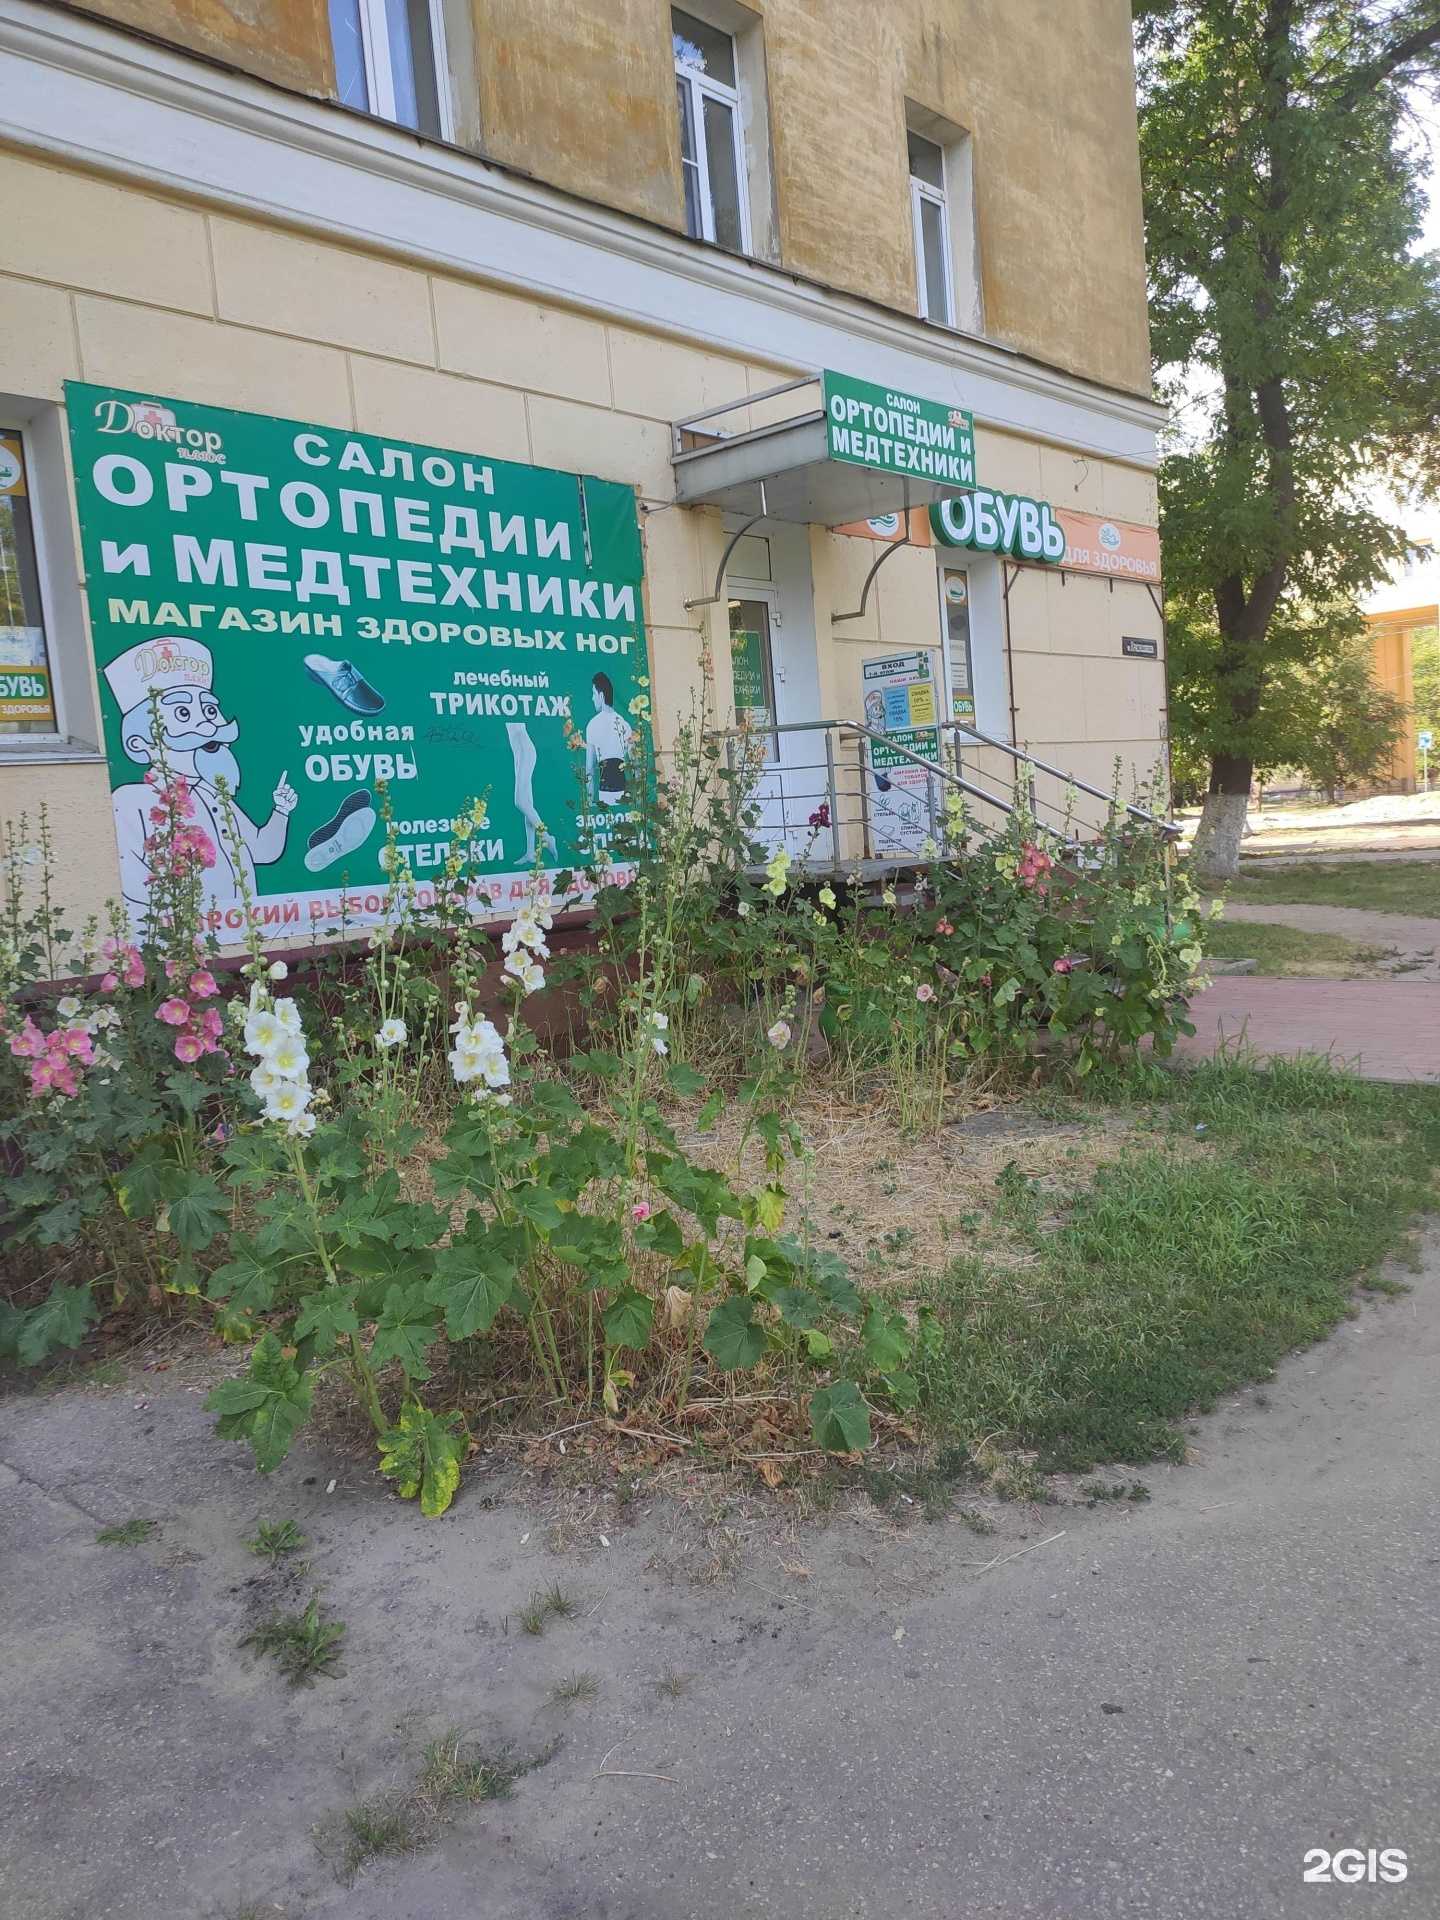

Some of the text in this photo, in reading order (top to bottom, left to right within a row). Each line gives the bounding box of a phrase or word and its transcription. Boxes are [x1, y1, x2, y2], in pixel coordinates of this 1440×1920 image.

[830, 394, 955, 451] ОРТОПЕДИИ
[886, 393, 921, 415] САЛОН
[293, 433, 495, 495] САЛОН
[832, 426, 973, 483] МЕДТЕХНИКИ
[92, 453, 571, 561] ОРТОПЕДИИ
[940, 491, 1065, 558] ОБУВЬ
[172, 534, 636, 622] МЕДТЕХНИКИ
[1062, 545, 1158, 577] ДЛЯ ЗДОРОВЬЯ
[107, 598, 635, 655] МАГАЗИН ЗДОРОВЫХ НОГ
[453, 669, 550, 688] лечебный
[881, 661, 905, 670] ВХОД
[429, 691, 572, 717] ТРИКОТАЖ
[299, 719, 415, 747] удобная
[304, 753, 418, 782] ОБУВЬ
